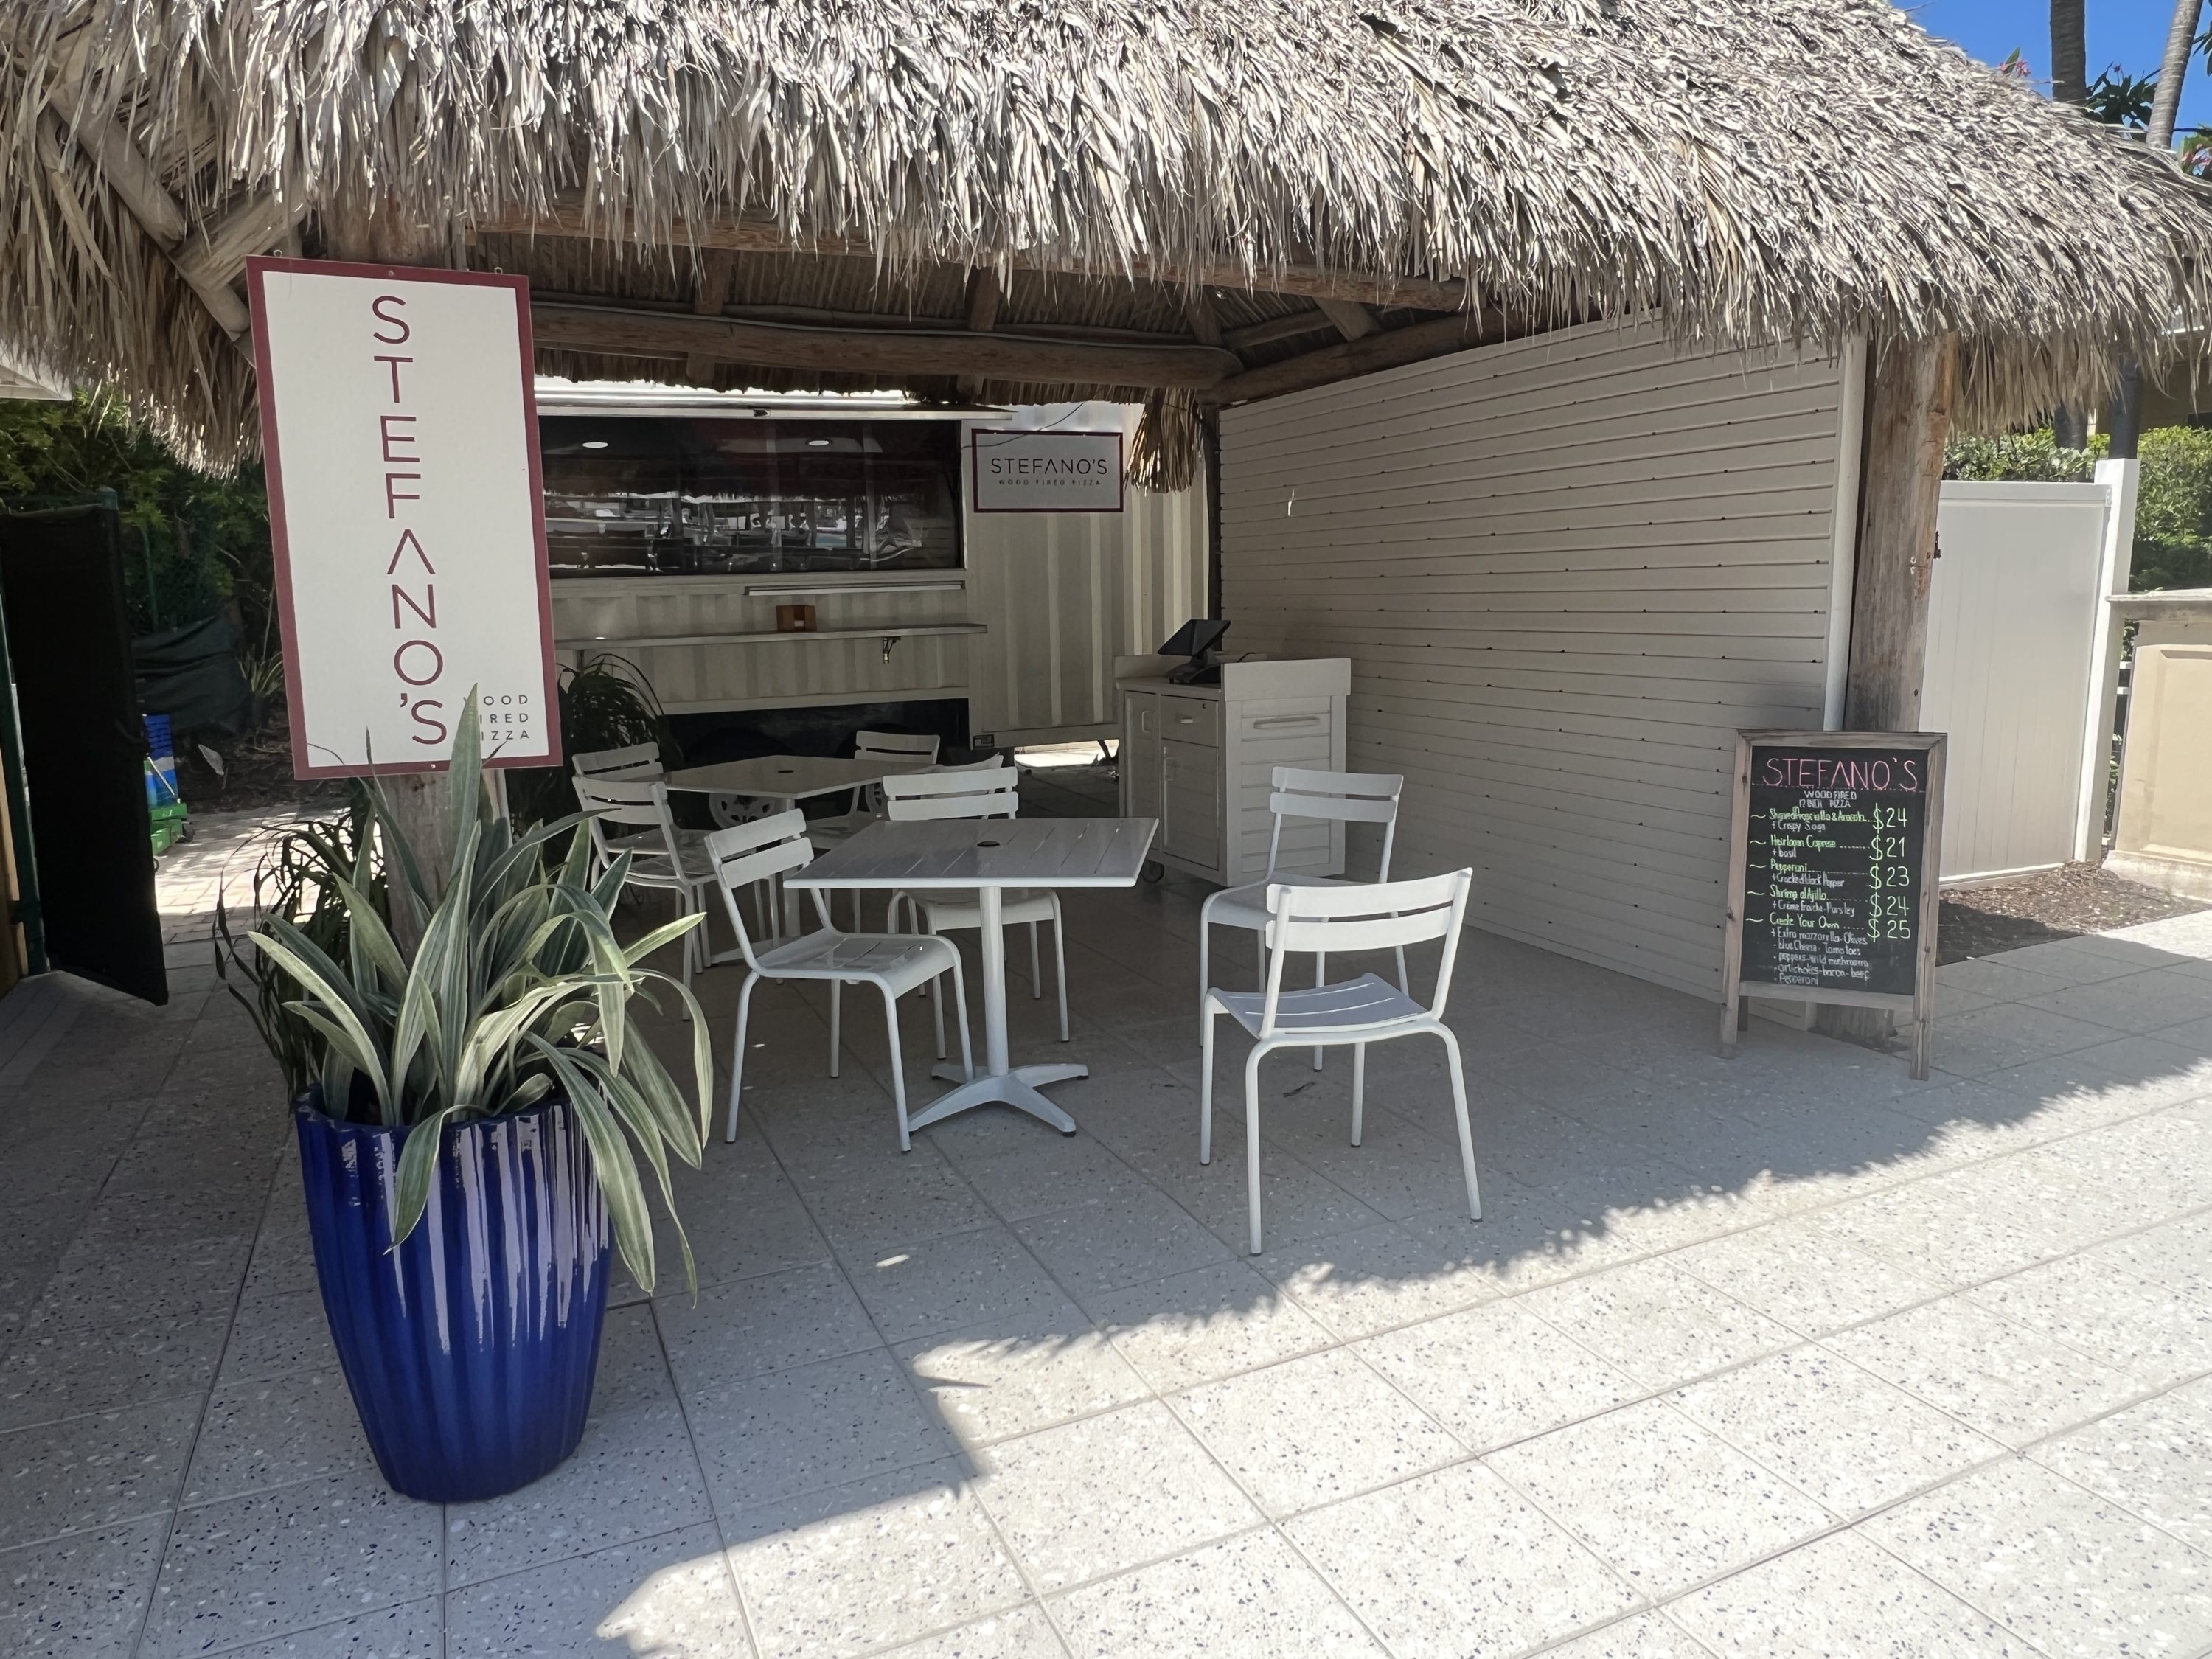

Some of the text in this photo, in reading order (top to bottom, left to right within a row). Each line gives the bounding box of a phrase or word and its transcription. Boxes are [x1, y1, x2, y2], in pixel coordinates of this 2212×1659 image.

[990, 458, 1107, 475] STEFANO'S
[372, 295, 448, 745] STEFANO'S
[463, 695, 528, 706] OOD
[479, 713, 529, 724] IRED
[481, 730, 529, 741] IZZA
[1762, 757, 1918, 791] STEFANO'S
[1804, 790, 1857, 800] WOOD FIRED
[1829, 799, 1851, 808] PIZZA
[1873, 802, 1908, 833] $24
[1869, 835, 1905, 861] $21
[1868, 863, 1910, 889] $23
[1869, 891, 1910, 917] $24
[1797, 913, 1815, 928] Your
[1818, 915, 1840, 929] Own
[1866, 919, 1911, 943] $25
